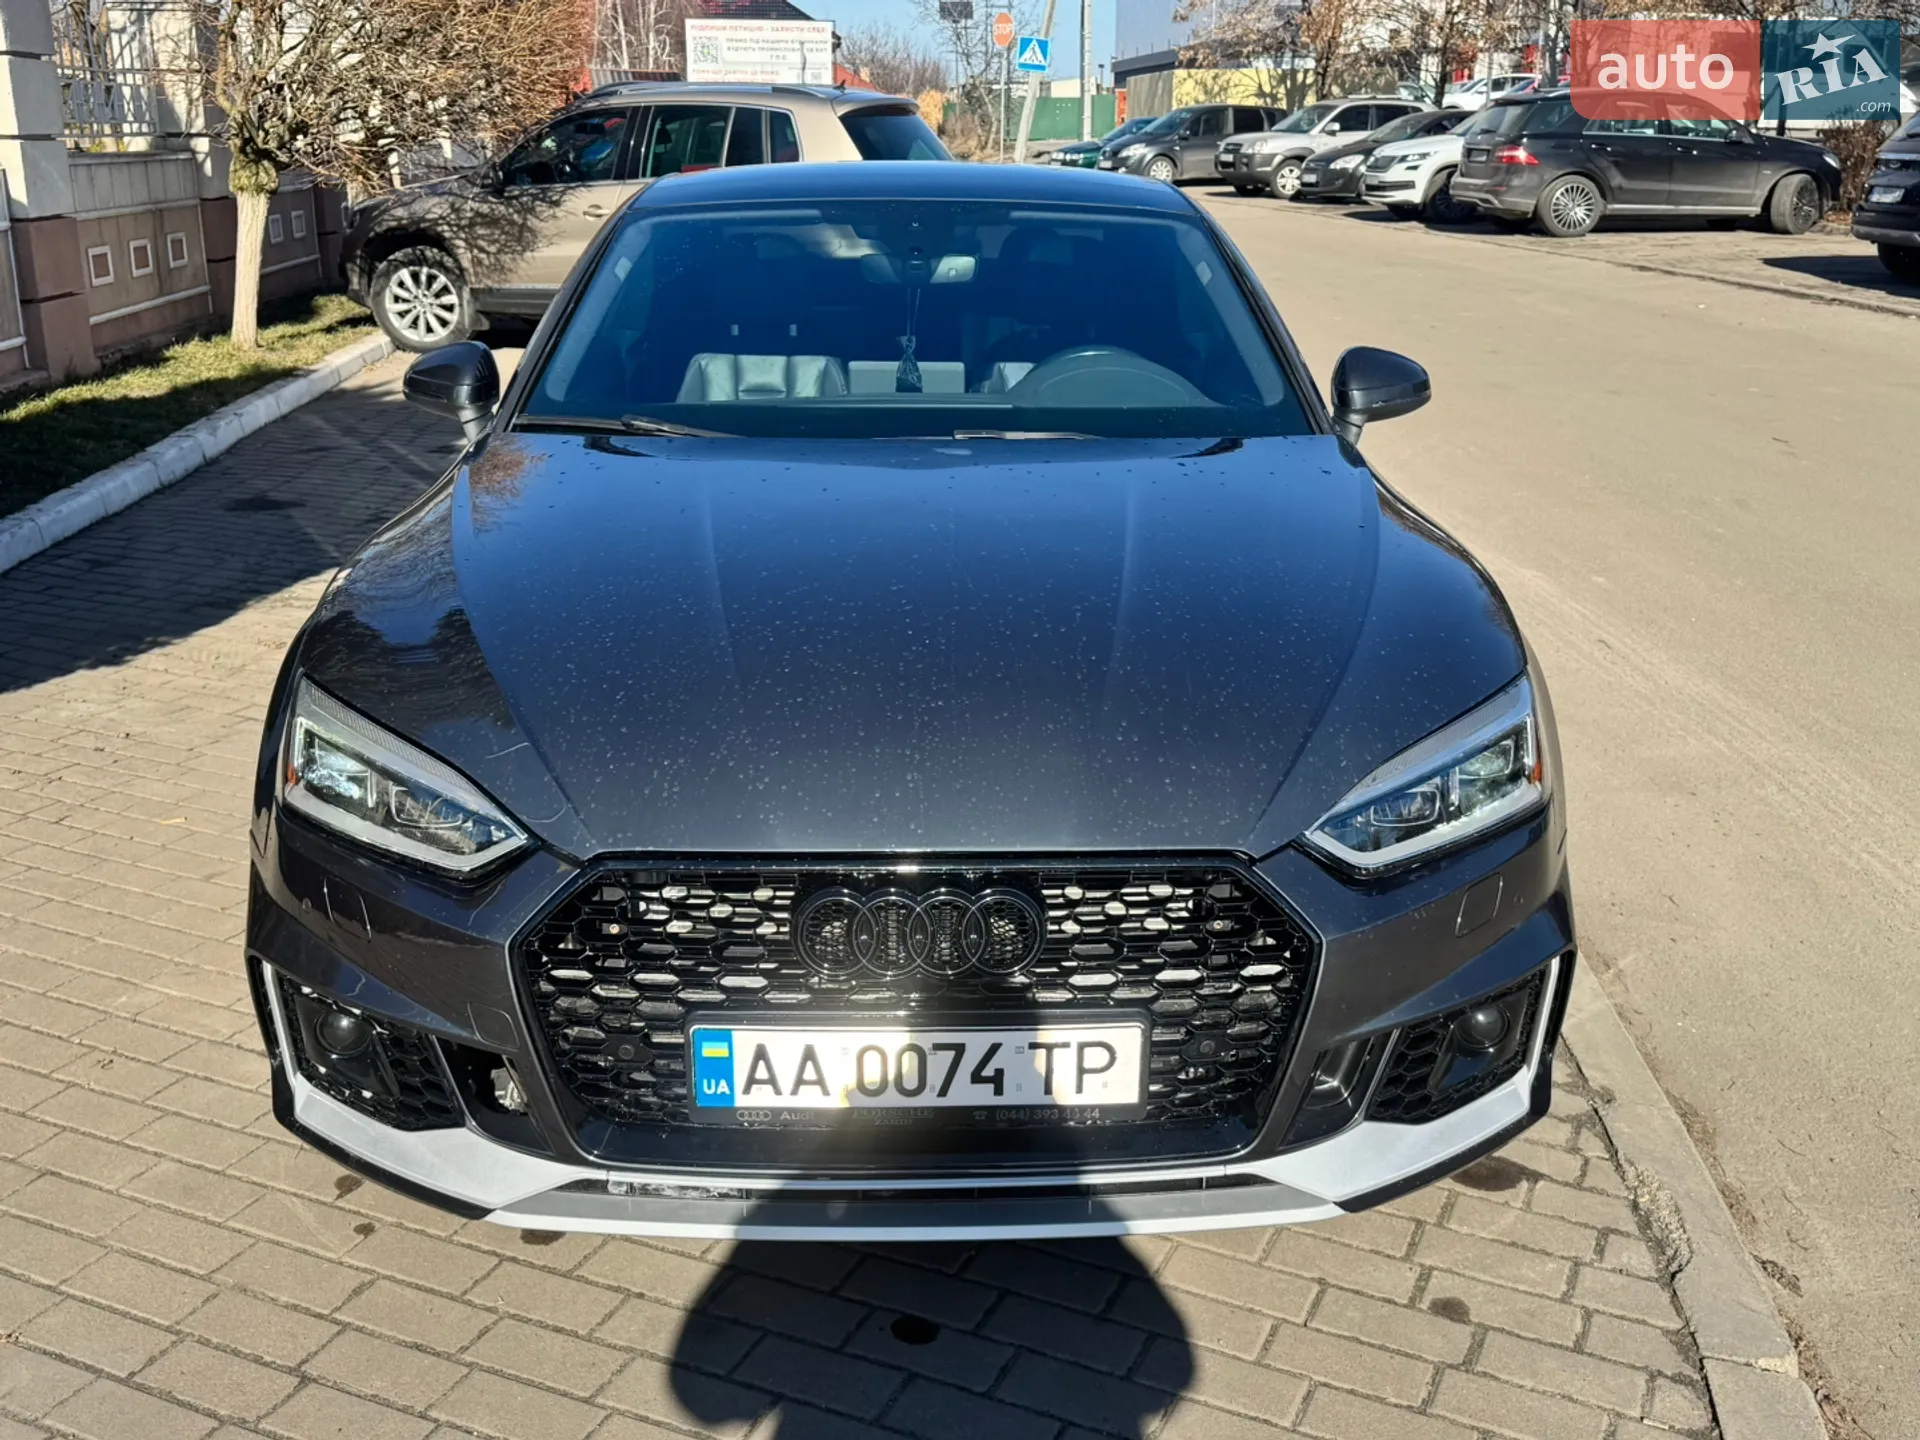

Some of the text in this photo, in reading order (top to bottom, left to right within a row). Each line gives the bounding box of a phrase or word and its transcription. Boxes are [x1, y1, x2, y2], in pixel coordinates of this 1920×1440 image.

[994, 23, 1013, 35] STOP
[742, 1041, 1117, 1098] AA 0074 TP
[703, 1079, 731, 1095] UA
[1033, 1109, 1060, 1120] 393
